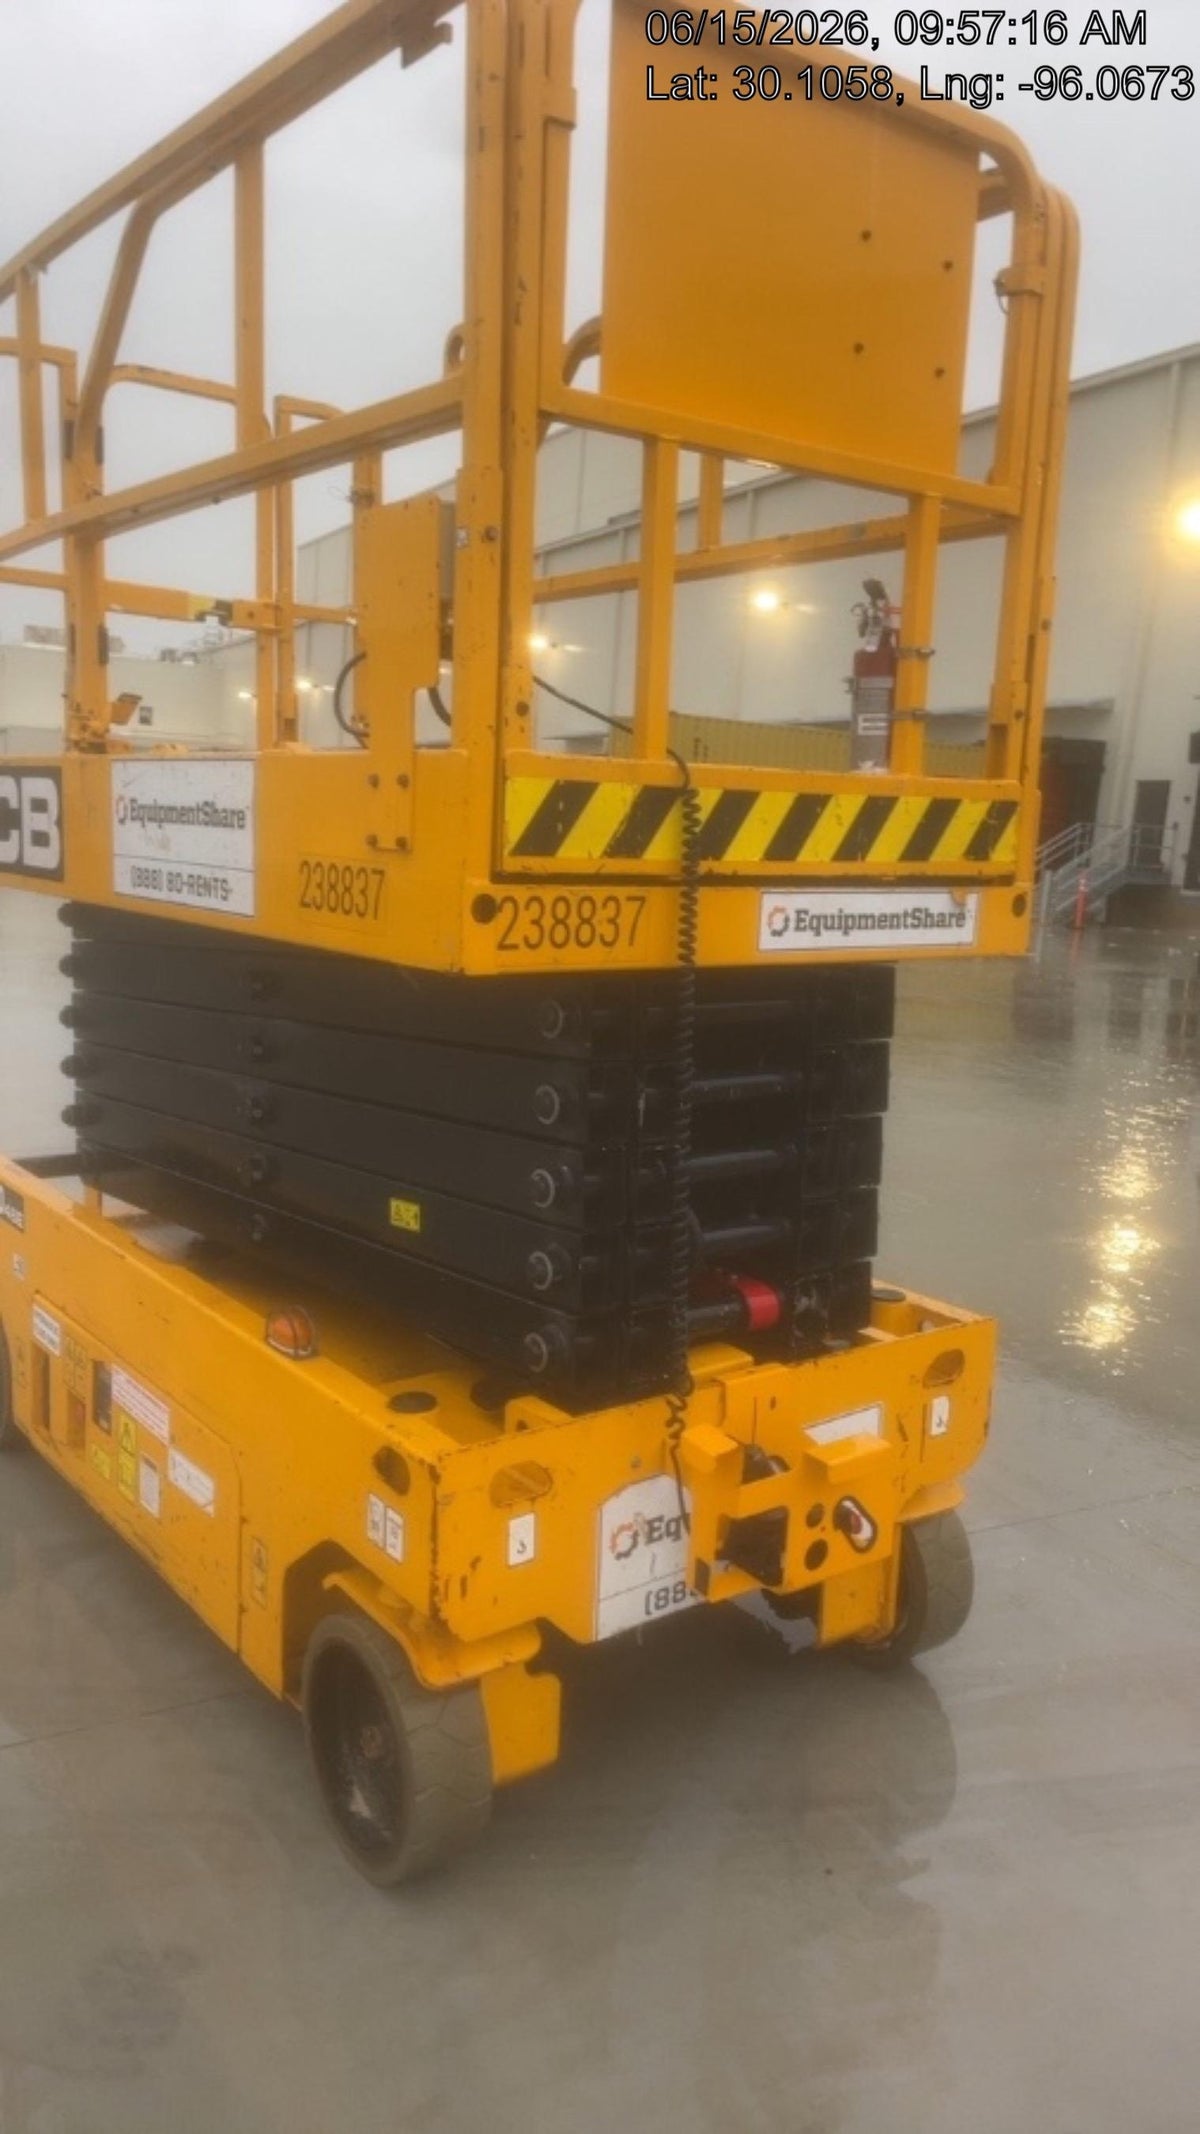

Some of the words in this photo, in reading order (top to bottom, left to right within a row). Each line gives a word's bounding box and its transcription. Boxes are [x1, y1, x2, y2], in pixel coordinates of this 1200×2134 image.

[129, 798, 246, 829] EquipmentShare
[299, 859, 386, 921] 238837
[497, 894, 646, 952] 238837
[794, 906, 967, 937] EquipmentShare
[645, 1580, 698, 1616] (88
